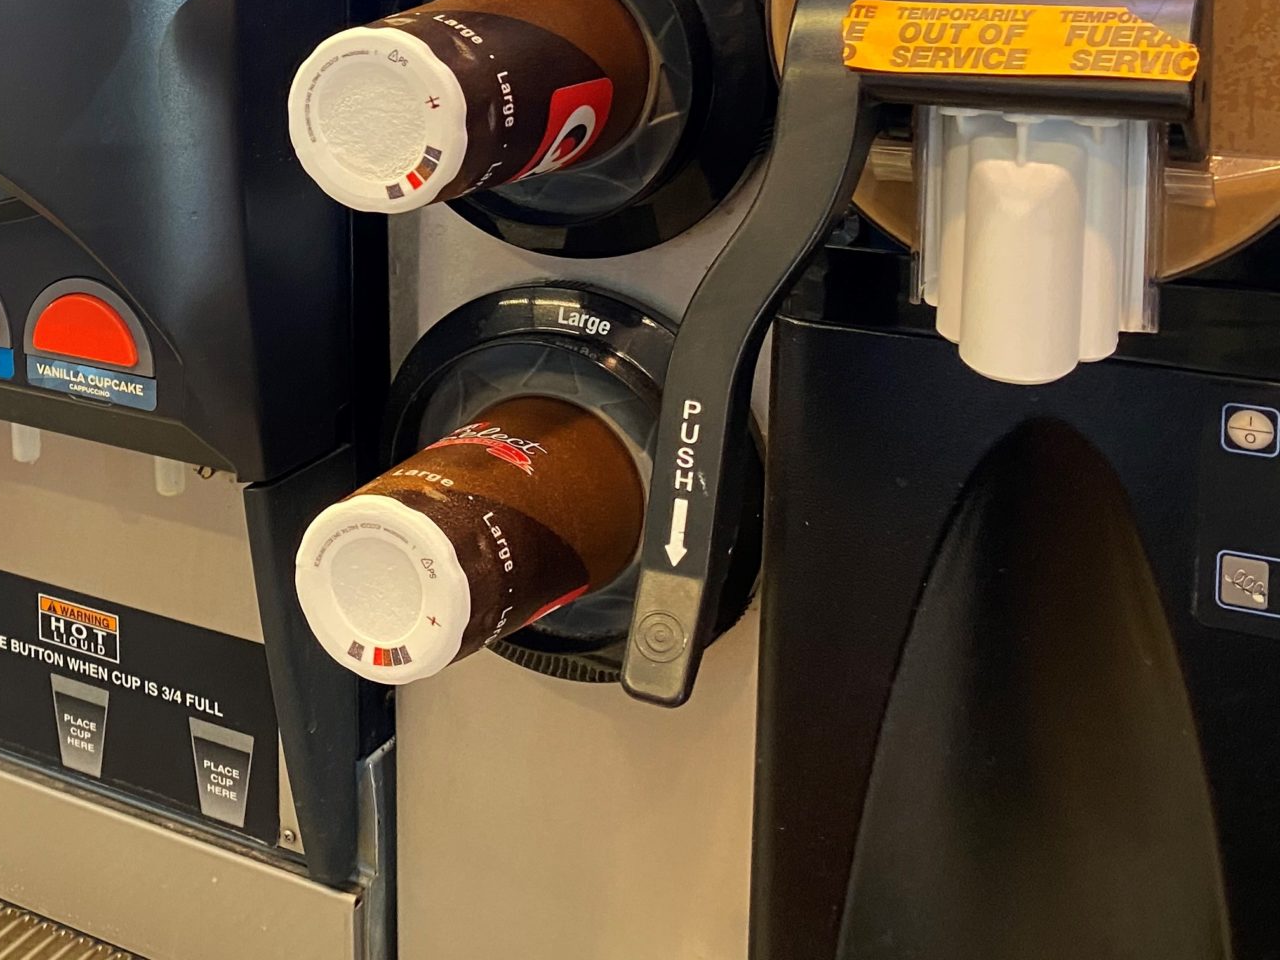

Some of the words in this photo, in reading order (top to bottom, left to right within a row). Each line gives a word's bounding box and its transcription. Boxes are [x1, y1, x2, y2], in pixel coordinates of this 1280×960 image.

[896, 7, 1036, 23] TEMPORARILY
[433, 14, 483, 45] Large
[898, 22, 970, 45] OUT
[978, 23, 1028, 46] OF
[1064, 25, 1180, 49] FUERA
[889, 45, 1031, 71] SERVICE
[1070, 49, 1198, 76] SERVIC
[496, 71, 514, 128] Large
[558, 307, 611, 335] Large
[37, 363, 85, 383] VANILLA
[88, 374, 144, 396] CUPCAKE
[69, 383, 111, 398] CAPPUCCINO
[674, 400, 702, 491] PUSH
[392, 469, 454, 487] Large
[483, 512, 514, 572] Large
[60, 603, 110, 629] WARNING
[50, 616, 107, 645] HOT
[53, 632, 106, 656] LIQUID
[11, 640, 64, 668] BUTTON
[66, 656, 108, 681] WHEN
[111, 670, 141, 691] CUP
[144, 680, 158, 696] IS
[161, 686, 182, 705] 3/4
[185, 692, 224, 717] FULL
[63, 713, 97, 732] PLACE
[70, 726, 91, 741] CUP
[67, 736, 95, 753] HERE
[203, 759, 240, 780] PLACE
[210, 773, 234, 788] CUP
[207, 784, 238, 802] HERE
